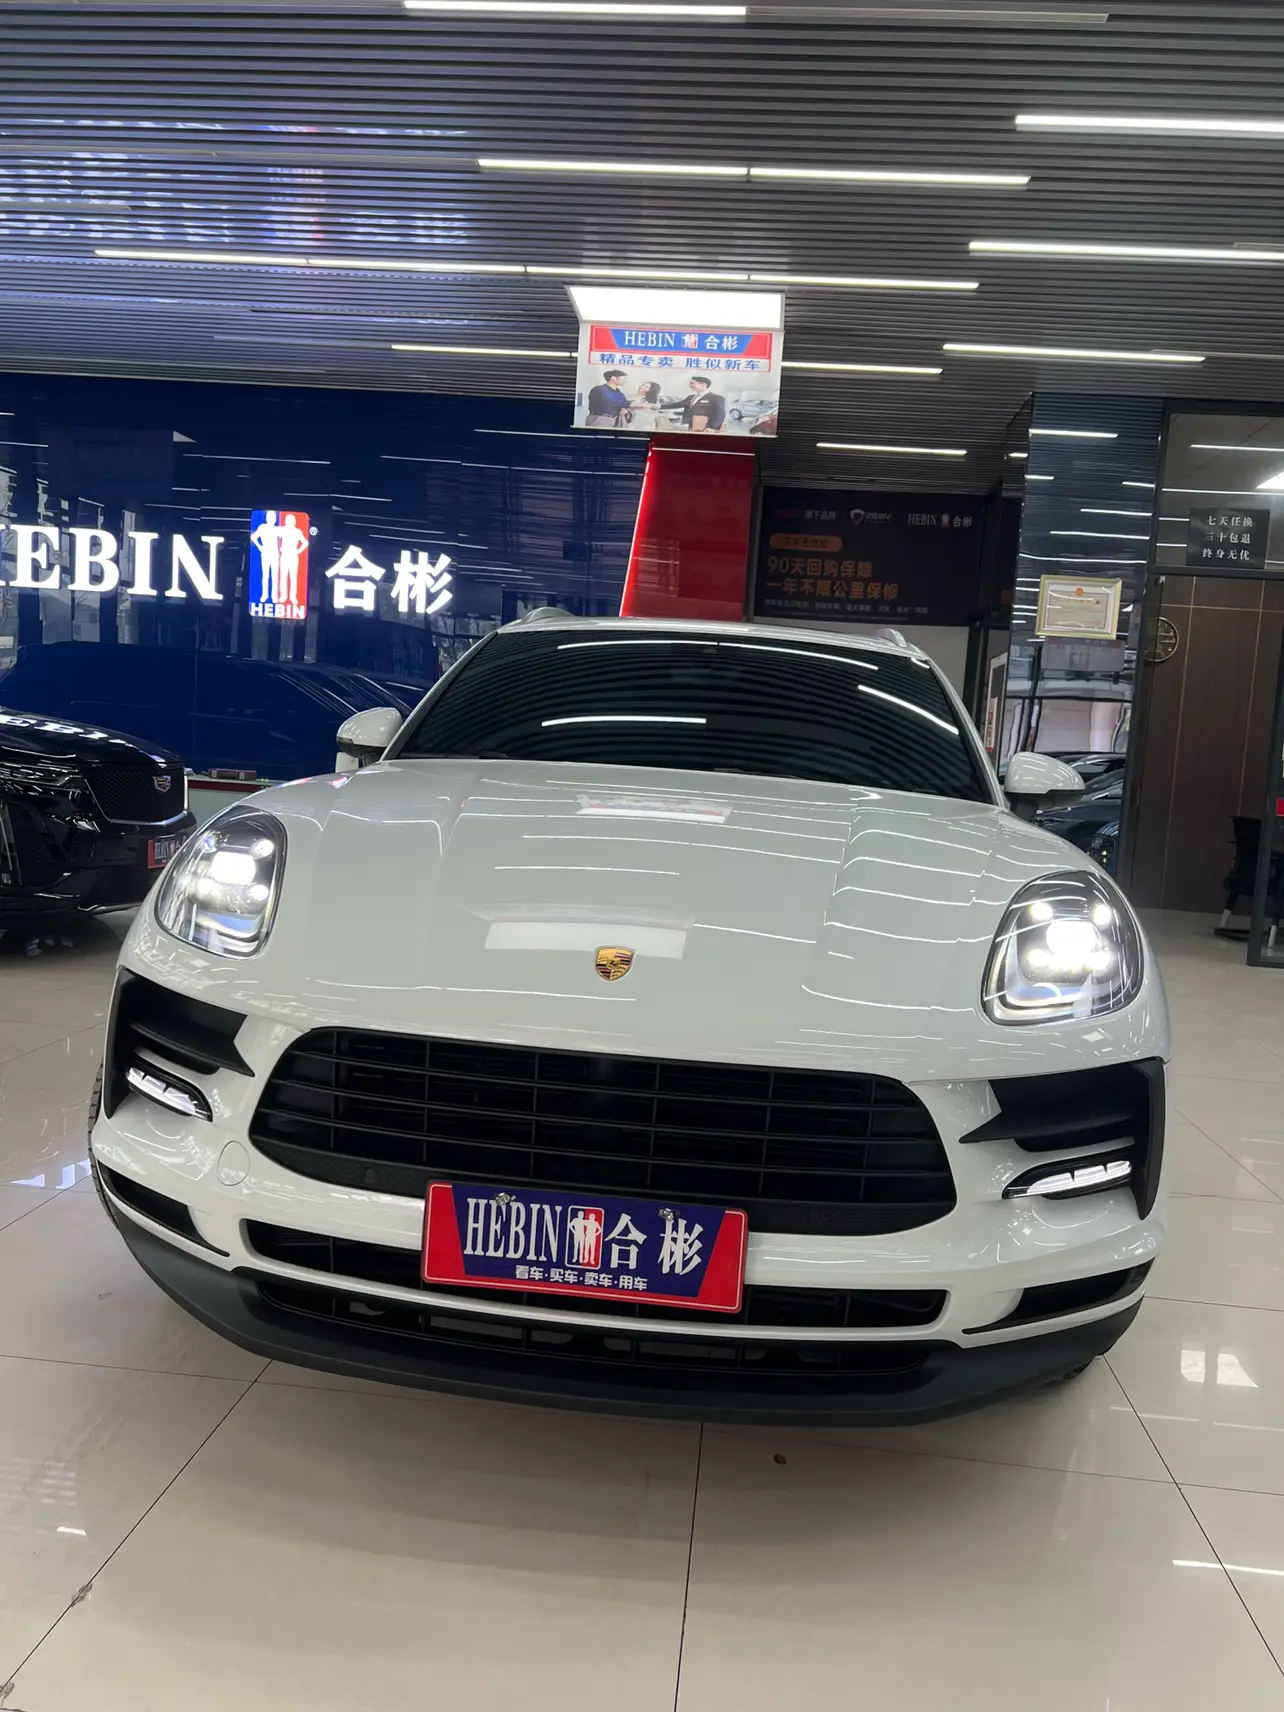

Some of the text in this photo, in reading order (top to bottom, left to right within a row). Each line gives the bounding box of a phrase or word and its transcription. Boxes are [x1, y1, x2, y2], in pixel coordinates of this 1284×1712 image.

[624, 331, 738, 351] HEBIN 合彬
[599, 353, 760, 370] 精品专卖 胜似新车
[908, 513, 938, 526] HEBIN
[1206, 515, 1254, 528] 七天任换
[1204, 532, 1252, 545] 三十包退
[0, 524, 454, 614] EBIN 合彬
[768, 556, 873, 580] 90天回购保障
[765, 577, 899, 602] 一年不限公里保修
[250, 602, 306, 620] HEBIN
[463, 1197, 704, 1276] HEBIN 合彬
